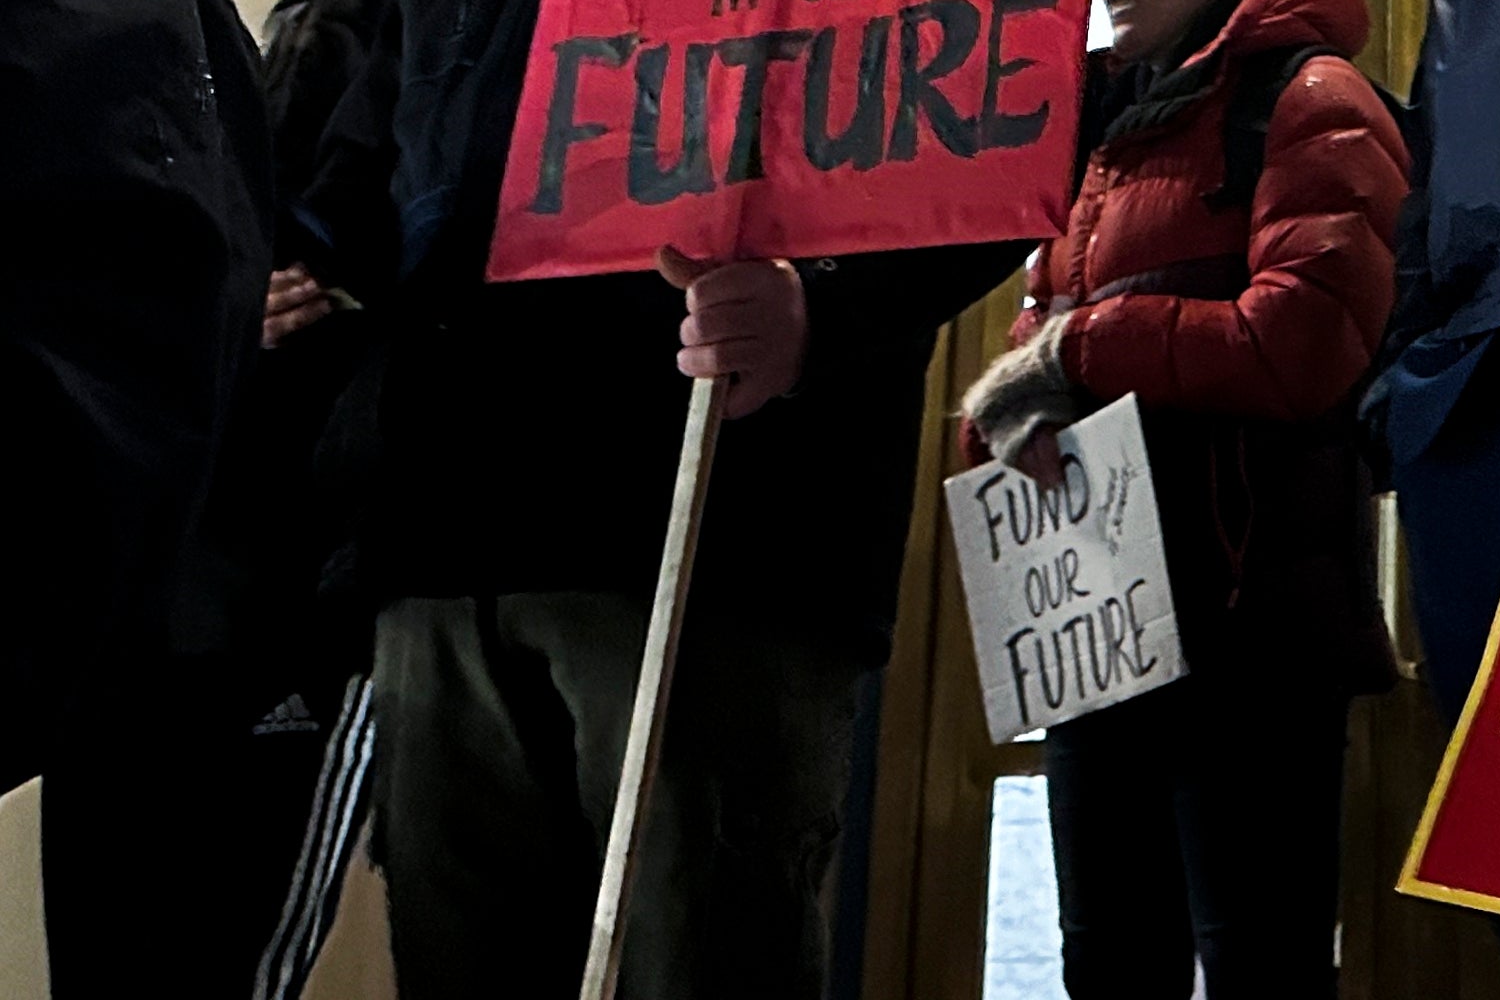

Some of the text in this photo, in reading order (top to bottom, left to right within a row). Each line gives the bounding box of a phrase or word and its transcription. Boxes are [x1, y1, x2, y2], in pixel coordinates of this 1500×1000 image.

[975, 452, 1091, 562] FUND
[1024, 548, 1091, 618] OUR
[1004, 578, 1157, 725] FUTURE
